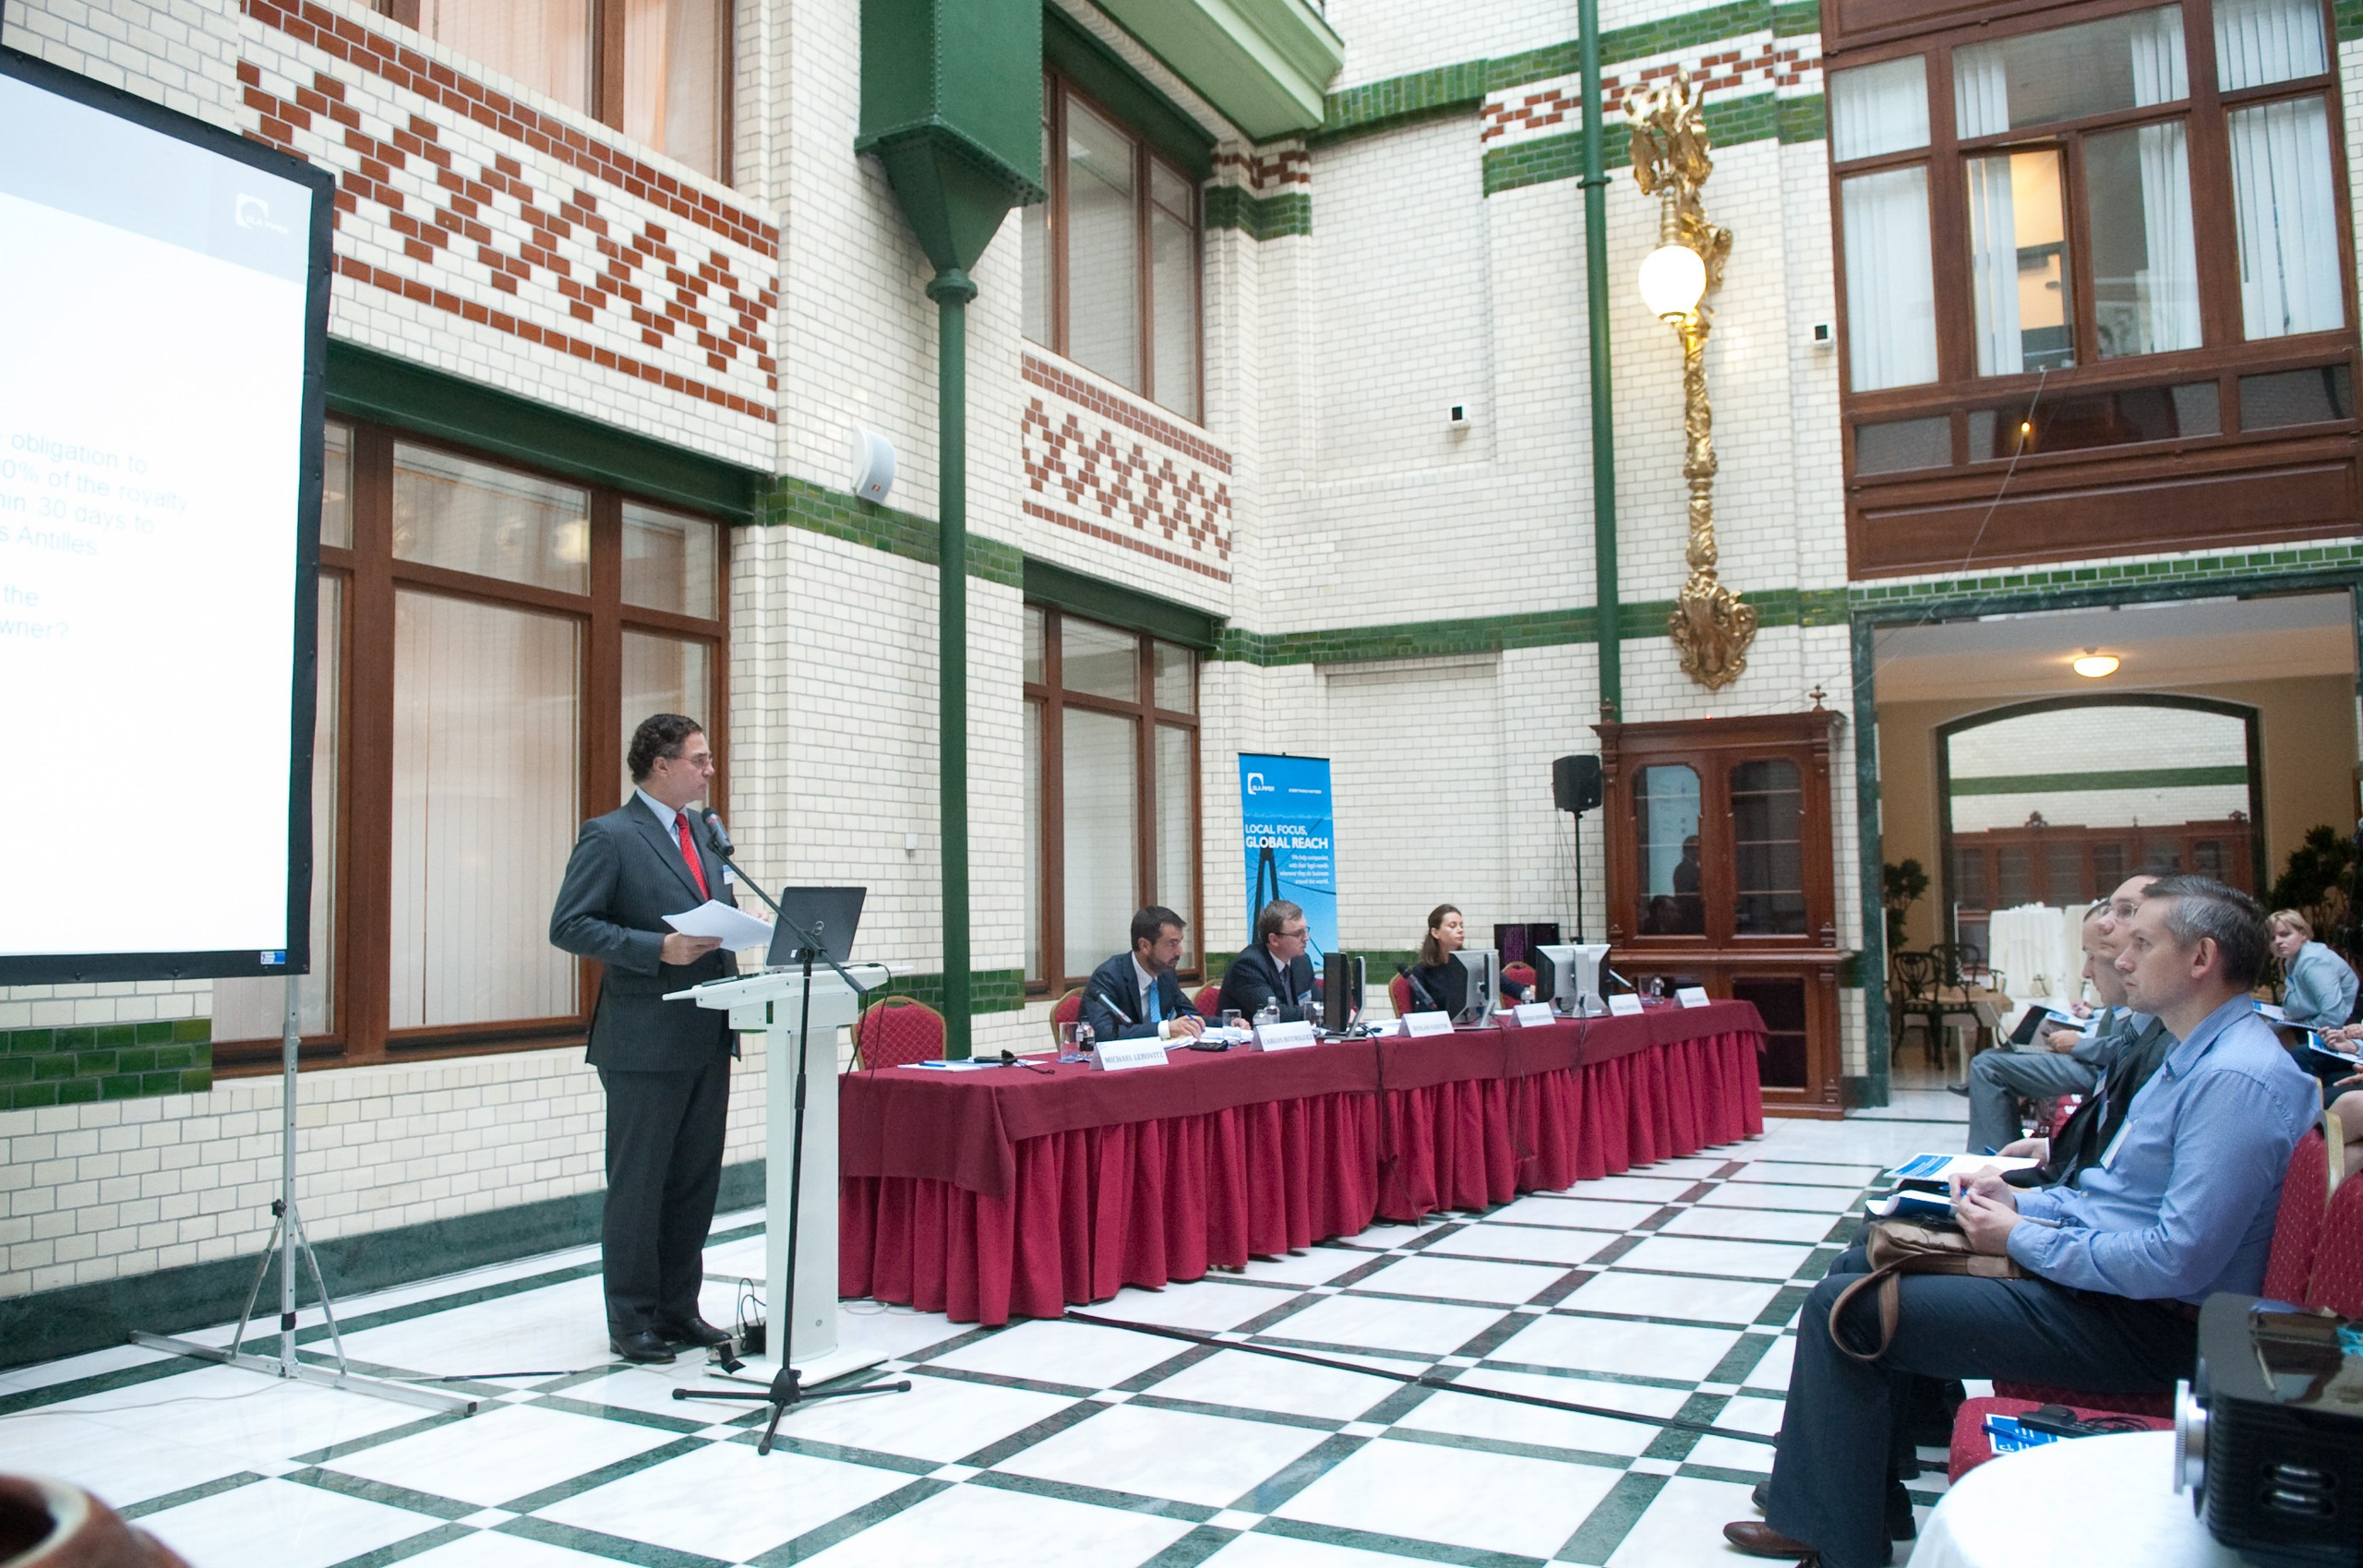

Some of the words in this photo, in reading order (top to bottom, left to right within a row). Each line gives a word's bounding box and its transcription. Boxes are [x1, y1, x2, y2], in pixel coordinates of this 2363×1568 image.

[11, 431, 118, 469] obligation
[128, 454, 149, 474] to
[48, 471, 71, 490] of
[77, 473, 110, 497] the
[118, 485, 189, 517] royalty
[38, 496, 66, 519] 30
[75, 506, 127, 533] days
[135, 514, 155, 535] to
[18, 524, 99, 556] Antilles
[3, 584, 40, 607] the
[1244, 823, 1276, 834] LOCAL
[1277, 824, 1308, 836] FOCUS,
[1245, 835, 1290, 848] GLOBAL
[1291, 837, 1328, 849] REACH
[1104, 1054, 1134, 1063] MICHAEL
